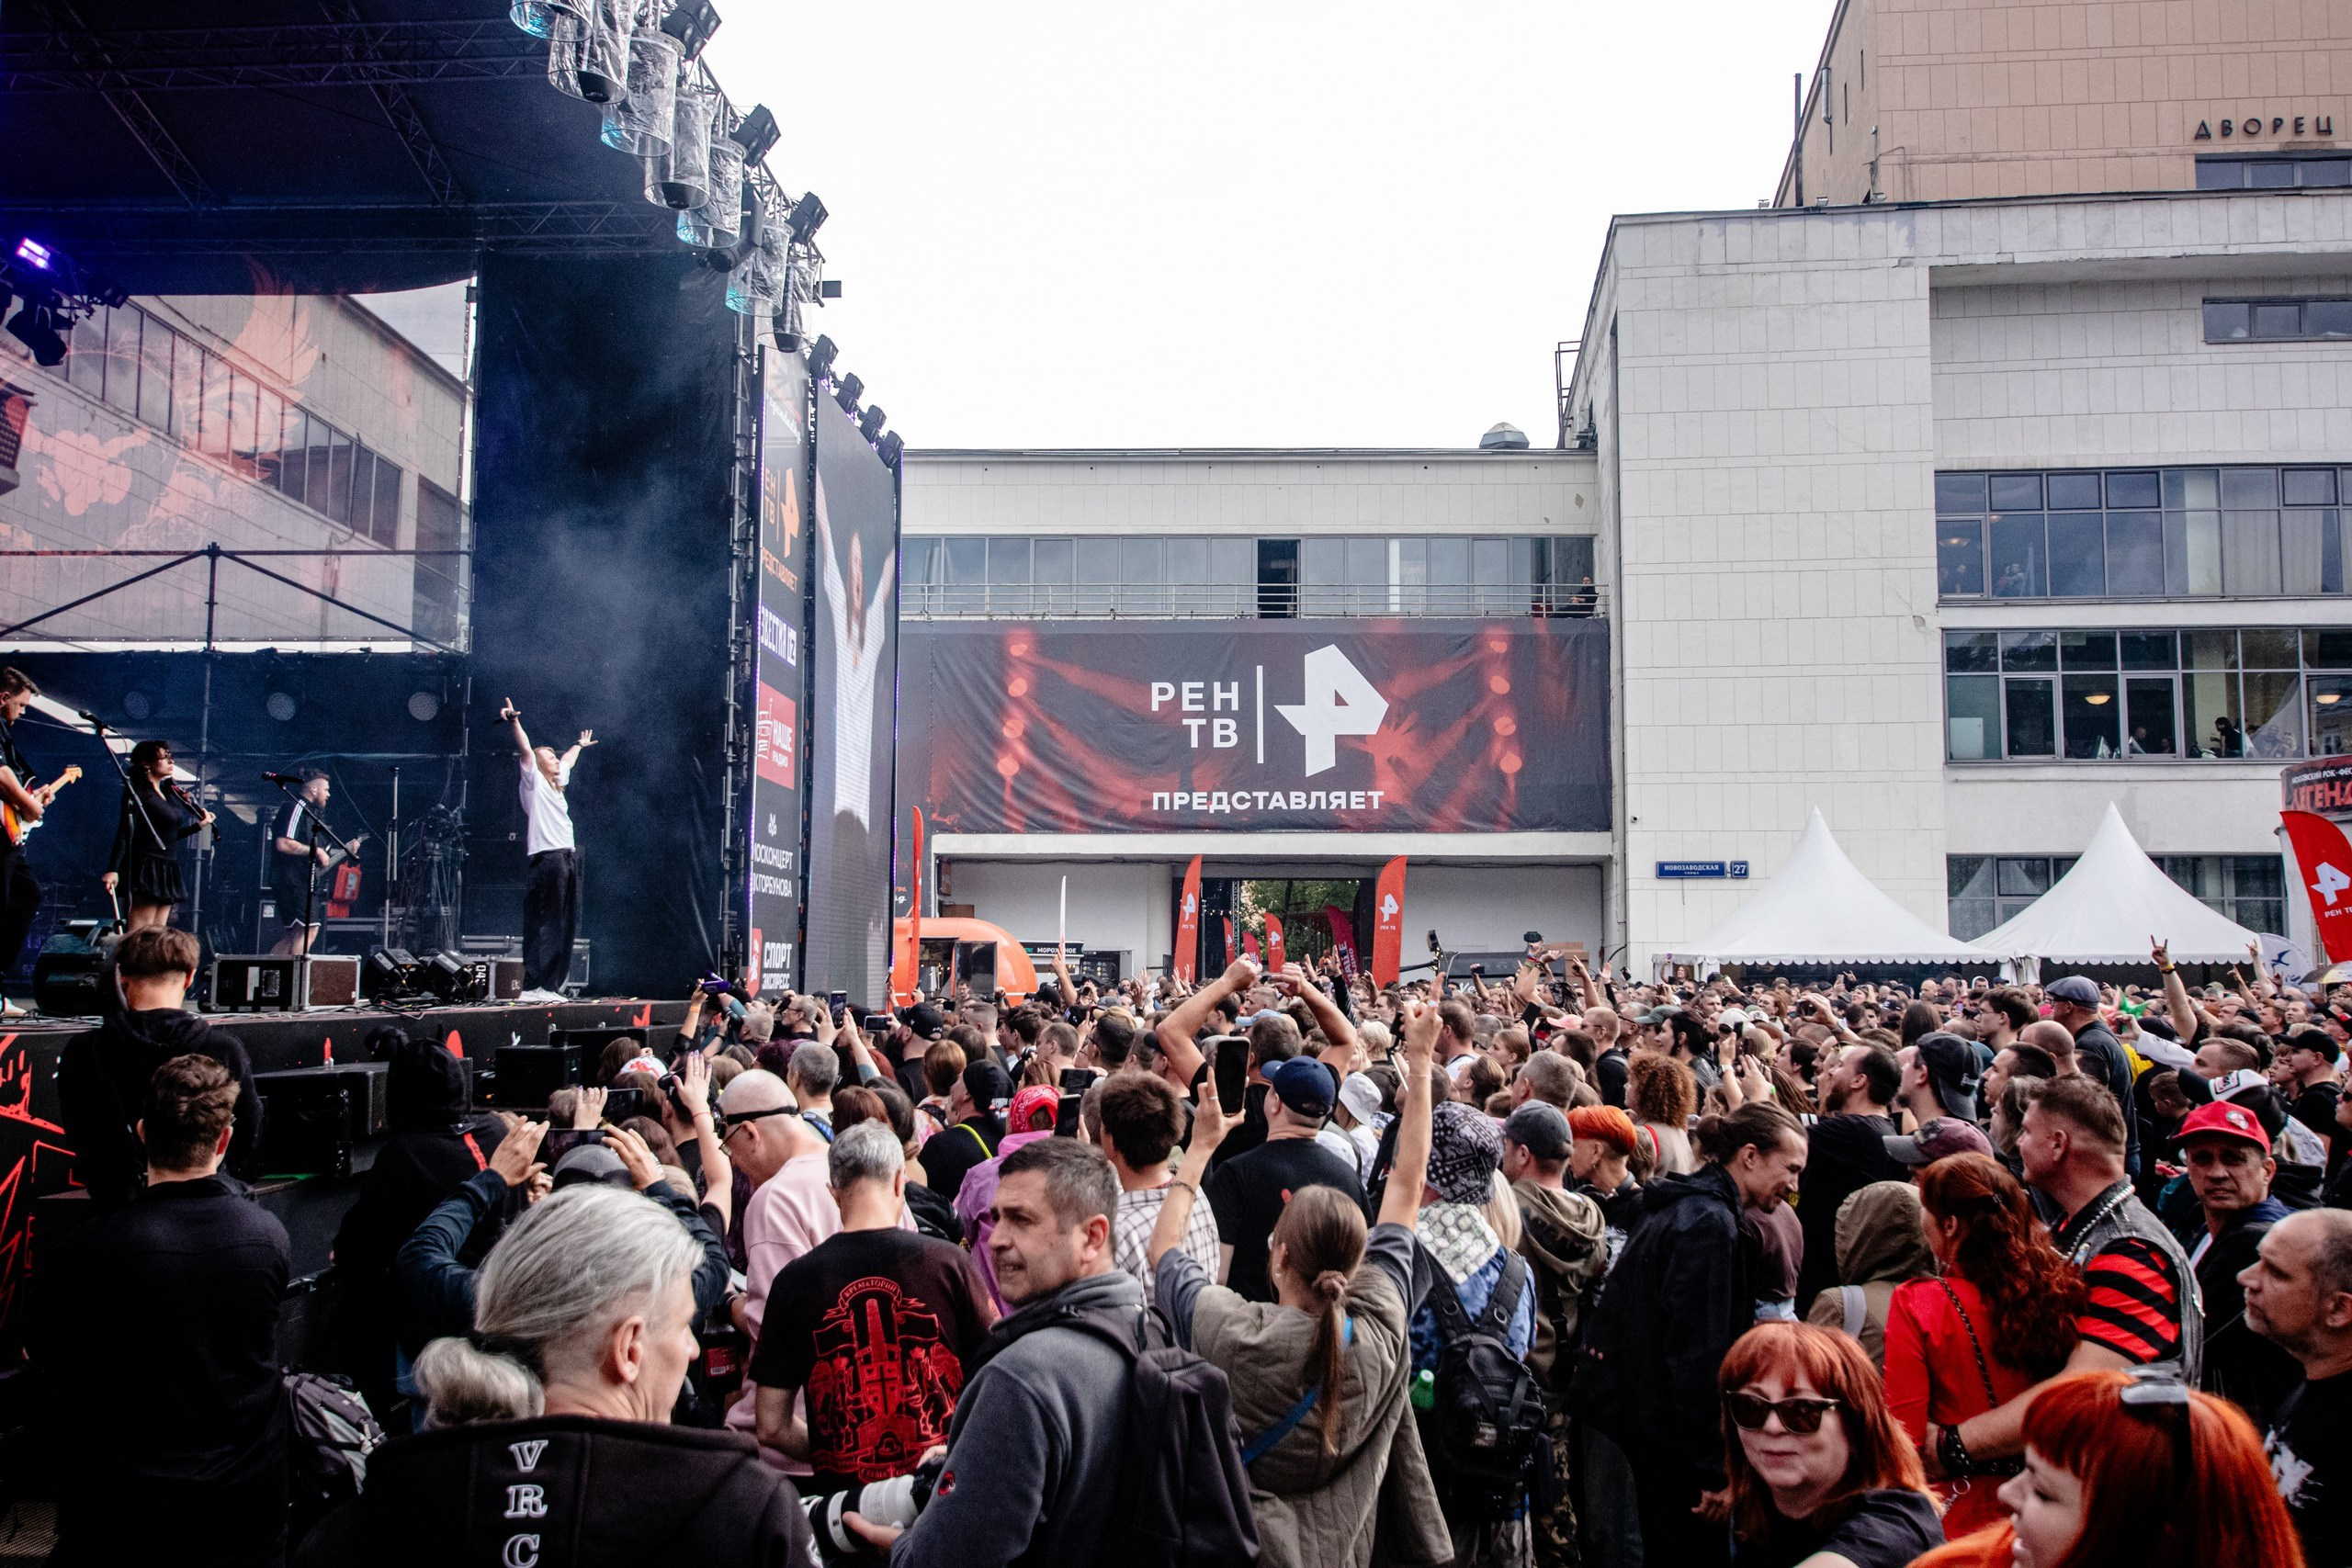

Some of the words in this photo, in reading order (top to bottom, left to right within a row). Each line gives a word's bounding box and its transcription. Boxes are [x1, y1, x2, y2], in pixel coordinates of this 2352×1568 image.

[2194, 116, 2333, 140] ДВОРЕЦ
[764, 467, 776, 498] ЕН
[764, 495, 775, 525] ТВ
[762, 546, 798, 593] РЕДСТАВЛЯЕТ
[761, 604, 786, 660] ЗВЕСТИЯ
[1151, 682, 1238, 711] РЕН
[773, 718, 793, 753] НАШЕ
[1182, 718, 1238, 749] ТВ
[772, 750, 789, 768] РАДИО
[1152, 791, 1385, 813] ПРЕДСТАВЛЯЕТ
[1734, 864, 1747, 874] 27
[759, 874, 793, 898] ГОРБУНОВА
[2324, 908, 2342, 919] РЕН
[763, 942, 792, 969] СПОРТ
[1348, 947, 1358, 974] АДИО
[762, 973, 790, 990] ЭКСПРЕСС
